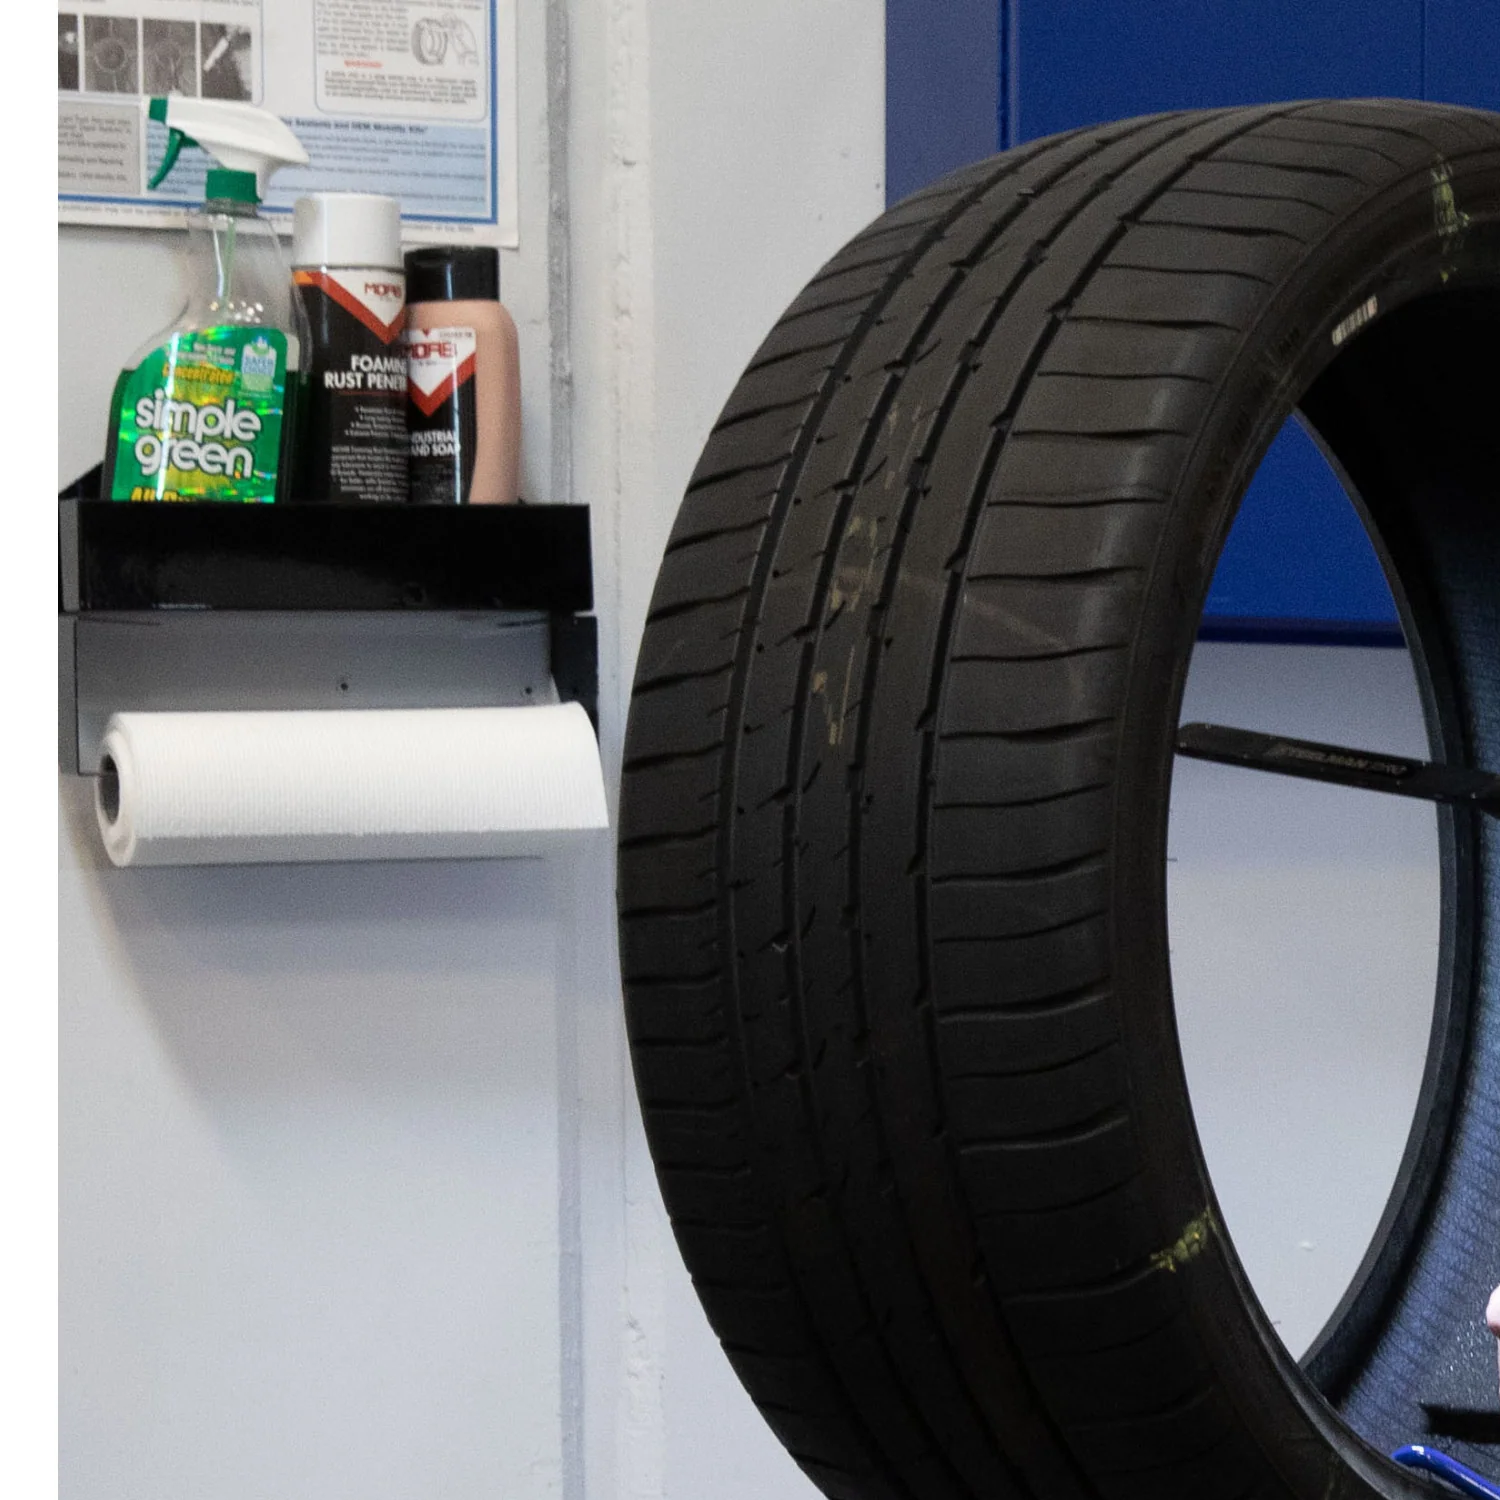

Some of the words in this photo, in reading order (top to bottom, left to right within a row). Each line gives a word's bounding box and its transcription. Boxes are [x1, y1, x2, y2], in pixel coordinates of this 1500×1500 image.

[324, 371, 364, 389] RUST
[135, 388, 262, 443] simple
[134, 434, 253, 478] green
